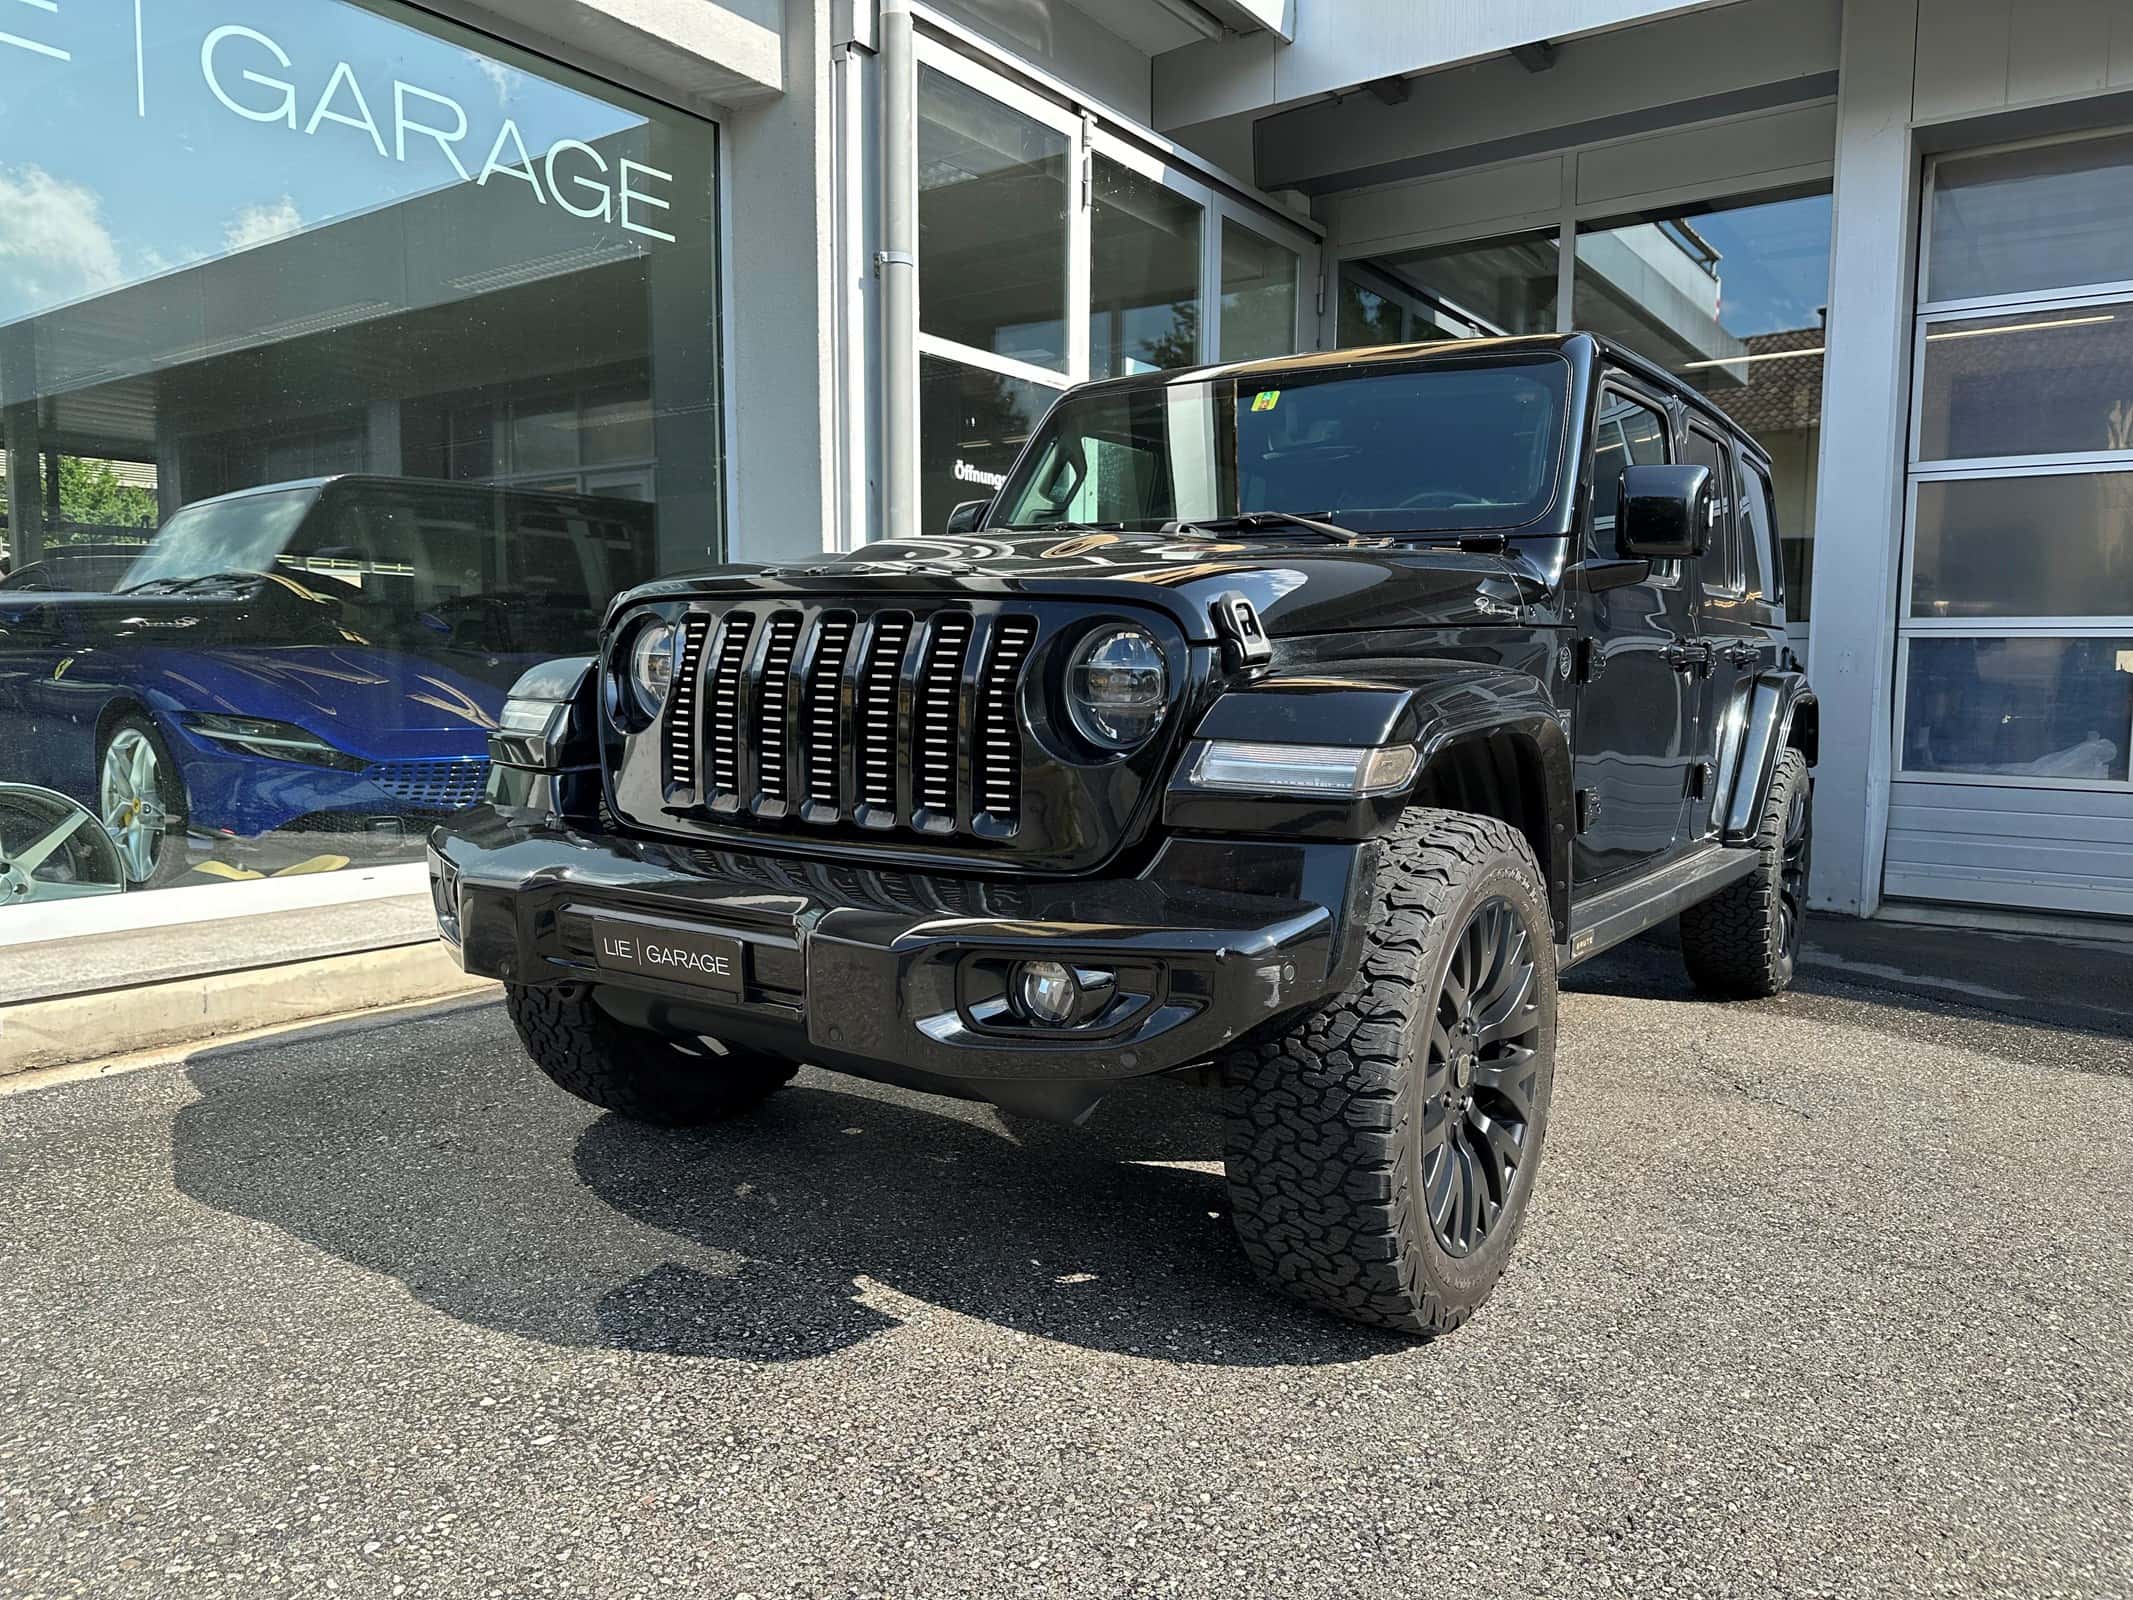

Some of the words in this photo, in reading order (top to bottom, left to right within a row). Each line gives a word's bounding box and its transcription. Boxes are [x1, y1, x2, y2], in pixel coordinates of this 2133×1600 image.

[201, 24, 676, 243] GARAGE
[604, 937, 633, 959] LIE
[646, 945, 731, 976] GARAGE
